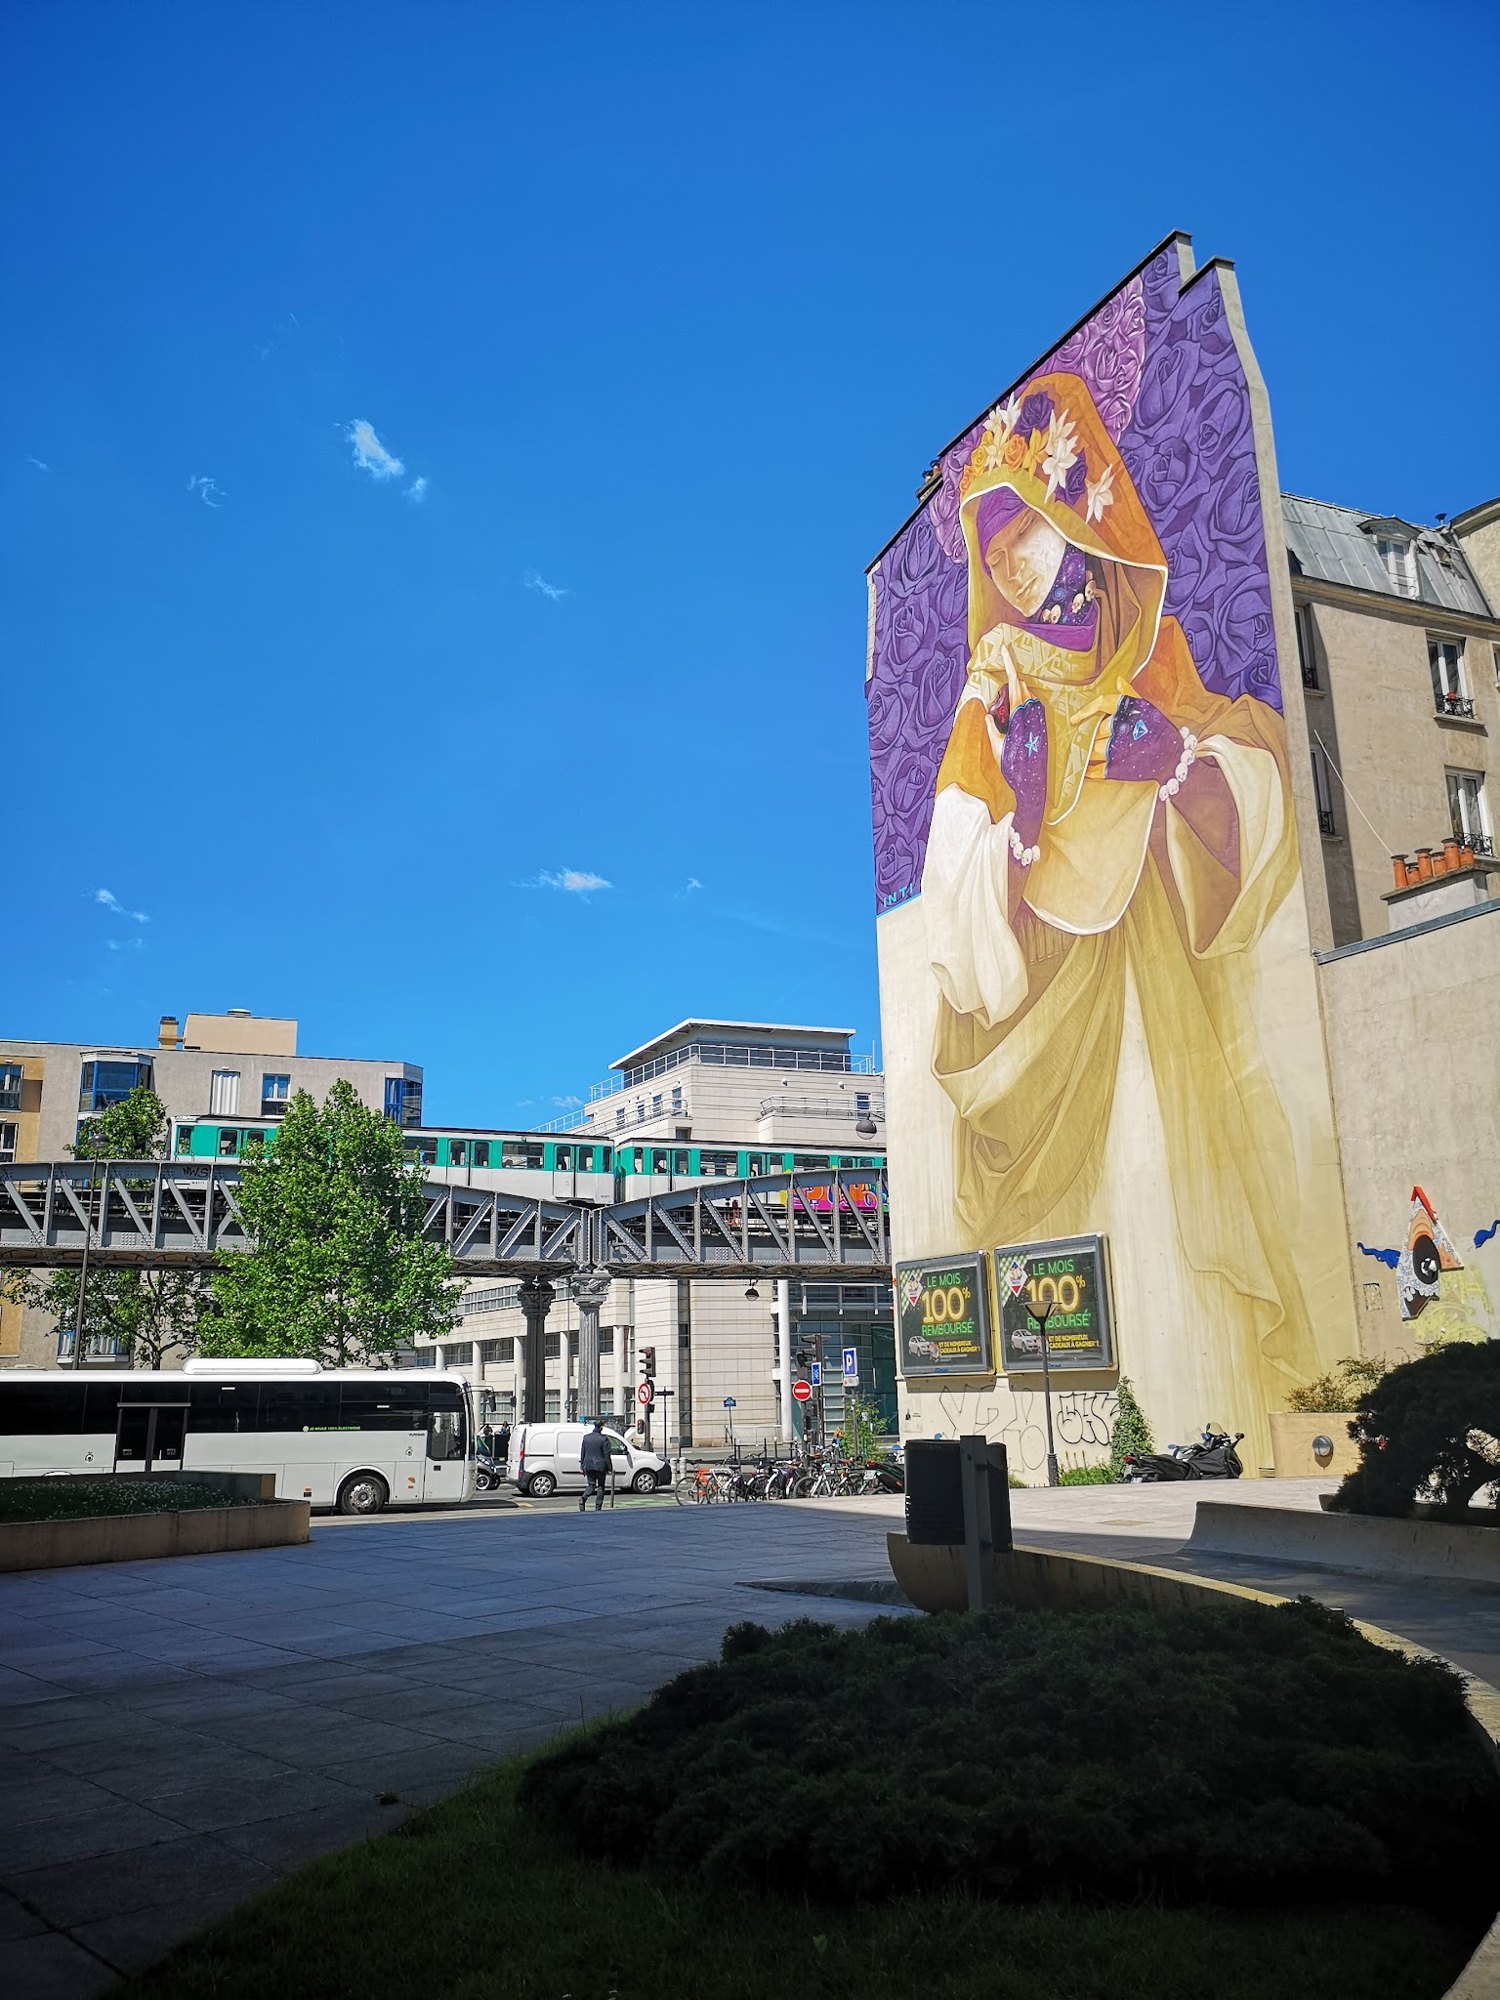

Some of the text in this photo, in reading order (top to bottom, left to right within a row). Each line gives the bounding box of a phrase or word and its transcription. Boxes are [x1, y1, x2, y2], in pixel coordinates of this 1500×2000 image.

[883, 883, 913, 907] INTI
[1033, 1259, 1074, 1276] LE MOIS
[927, 1272, 961, 1287] LE MOIS
[846, 1354, 853, 1371] P
